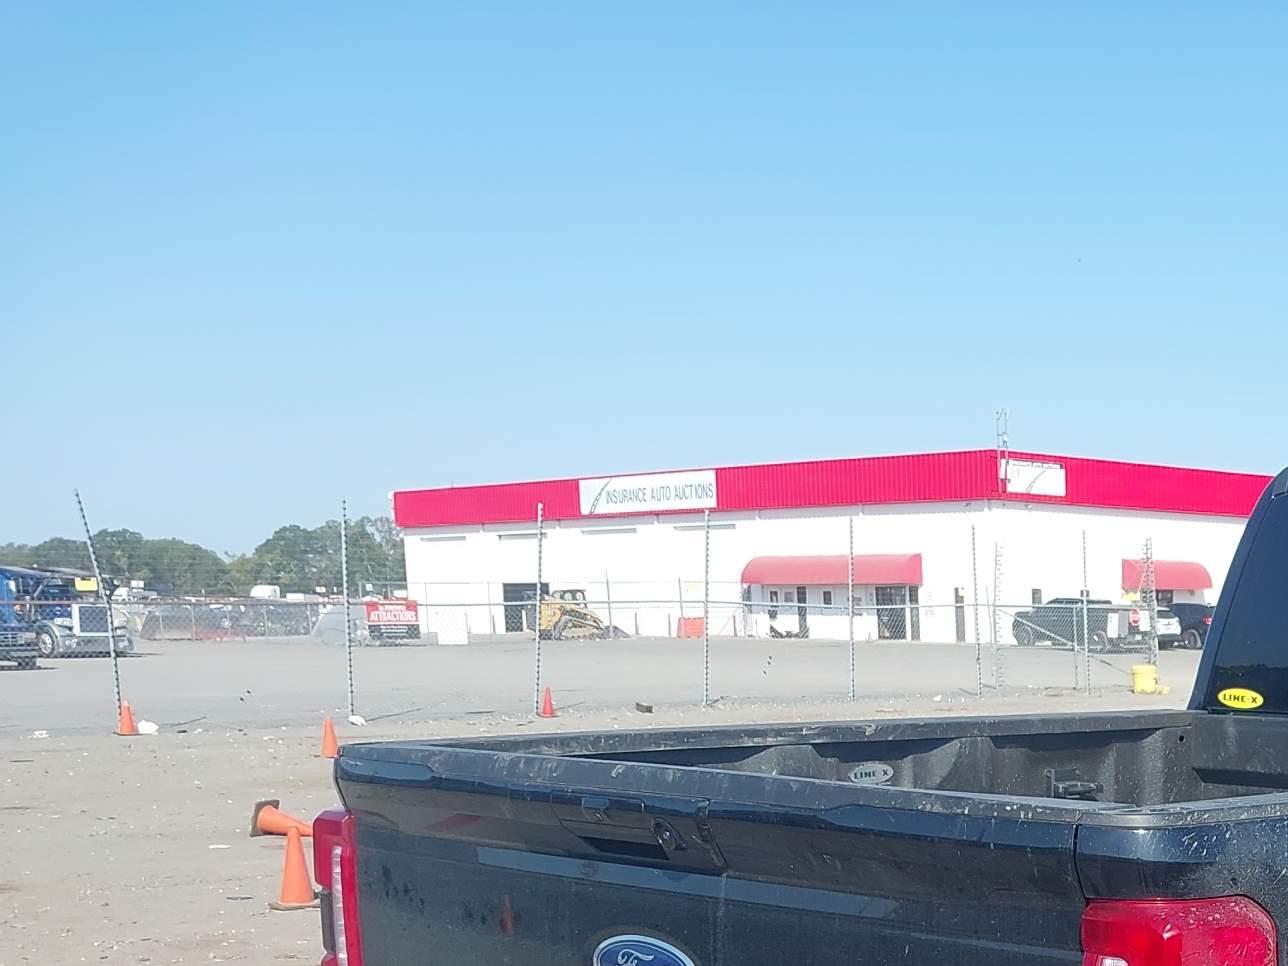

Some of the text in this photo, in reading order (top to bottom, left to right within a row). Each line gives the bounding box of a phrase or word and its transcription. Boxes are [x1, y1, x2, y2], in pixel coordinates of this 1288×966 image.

[606, 483, 714, 505] INSURANCE AUTO AUCTIONS
[1223, 693, 1258, 704] LINE-X
